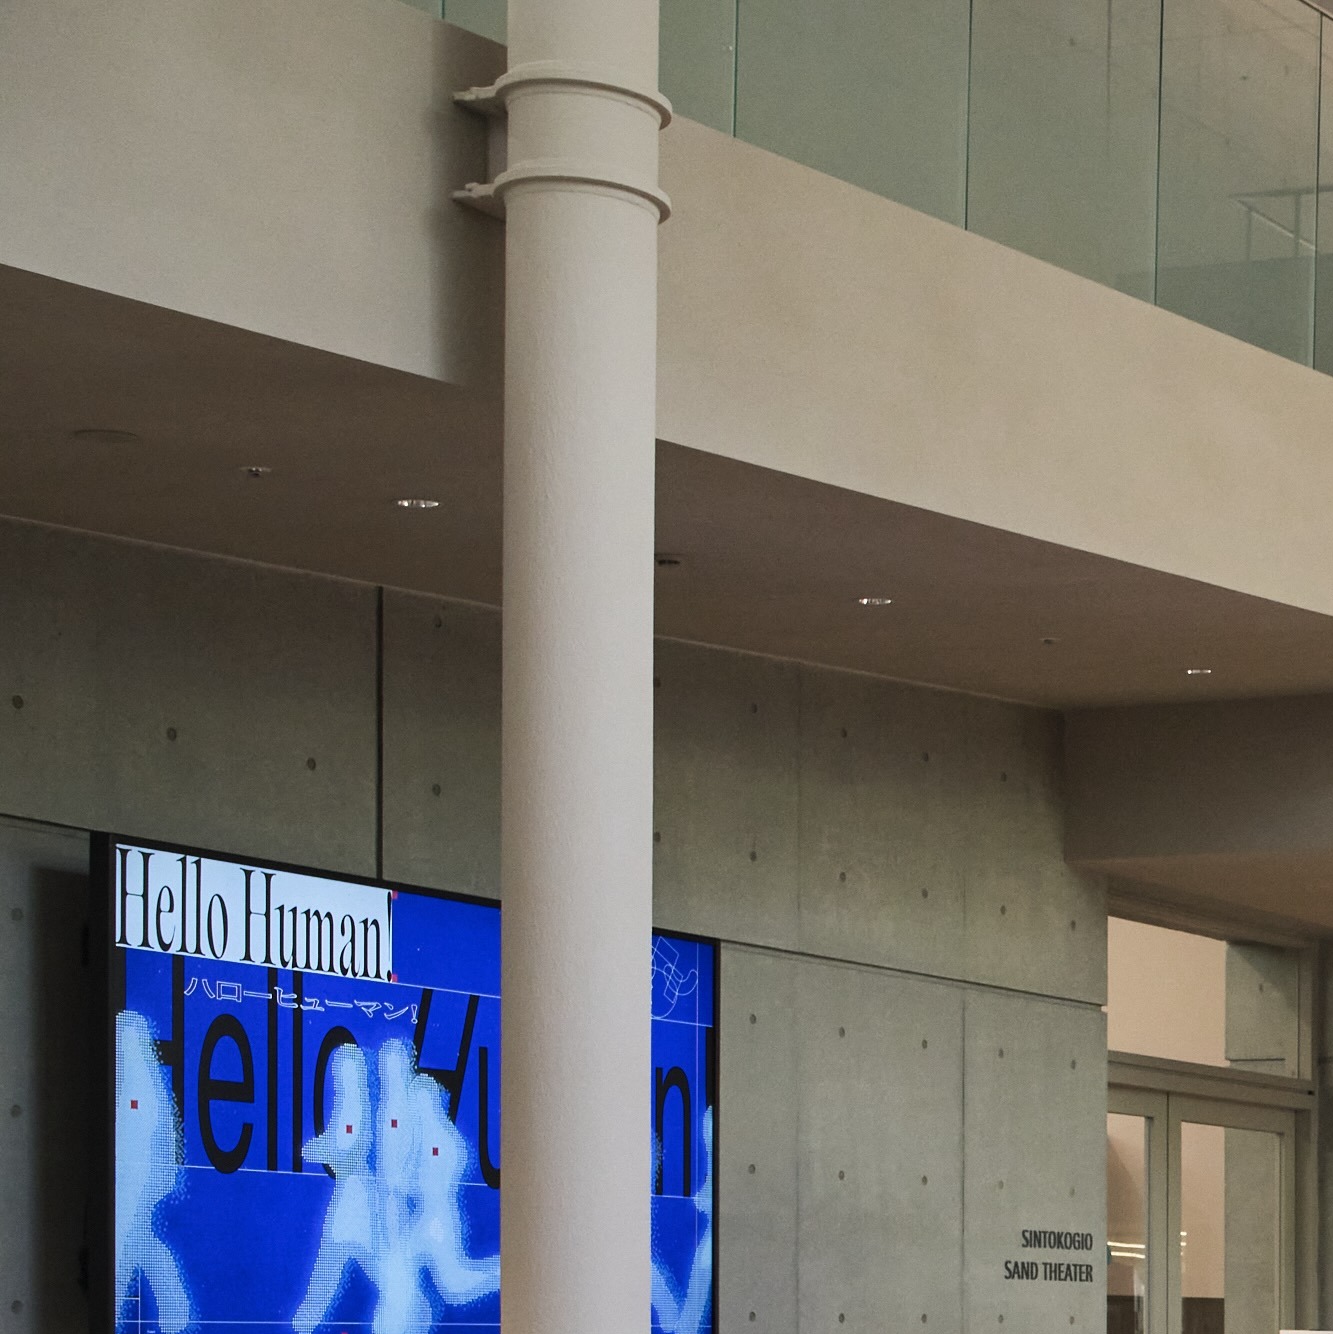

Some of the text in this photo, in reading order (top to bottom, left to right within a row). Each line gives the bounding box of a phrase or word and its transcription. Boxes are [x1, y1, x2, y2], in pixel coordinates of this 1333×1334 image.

[116, 848, 393, 983] Hello Human!
[1021, 1229, 1093, 1250] SINTOKOGIO
[1004, 1260, 1093, 1282] SAND THEATER
